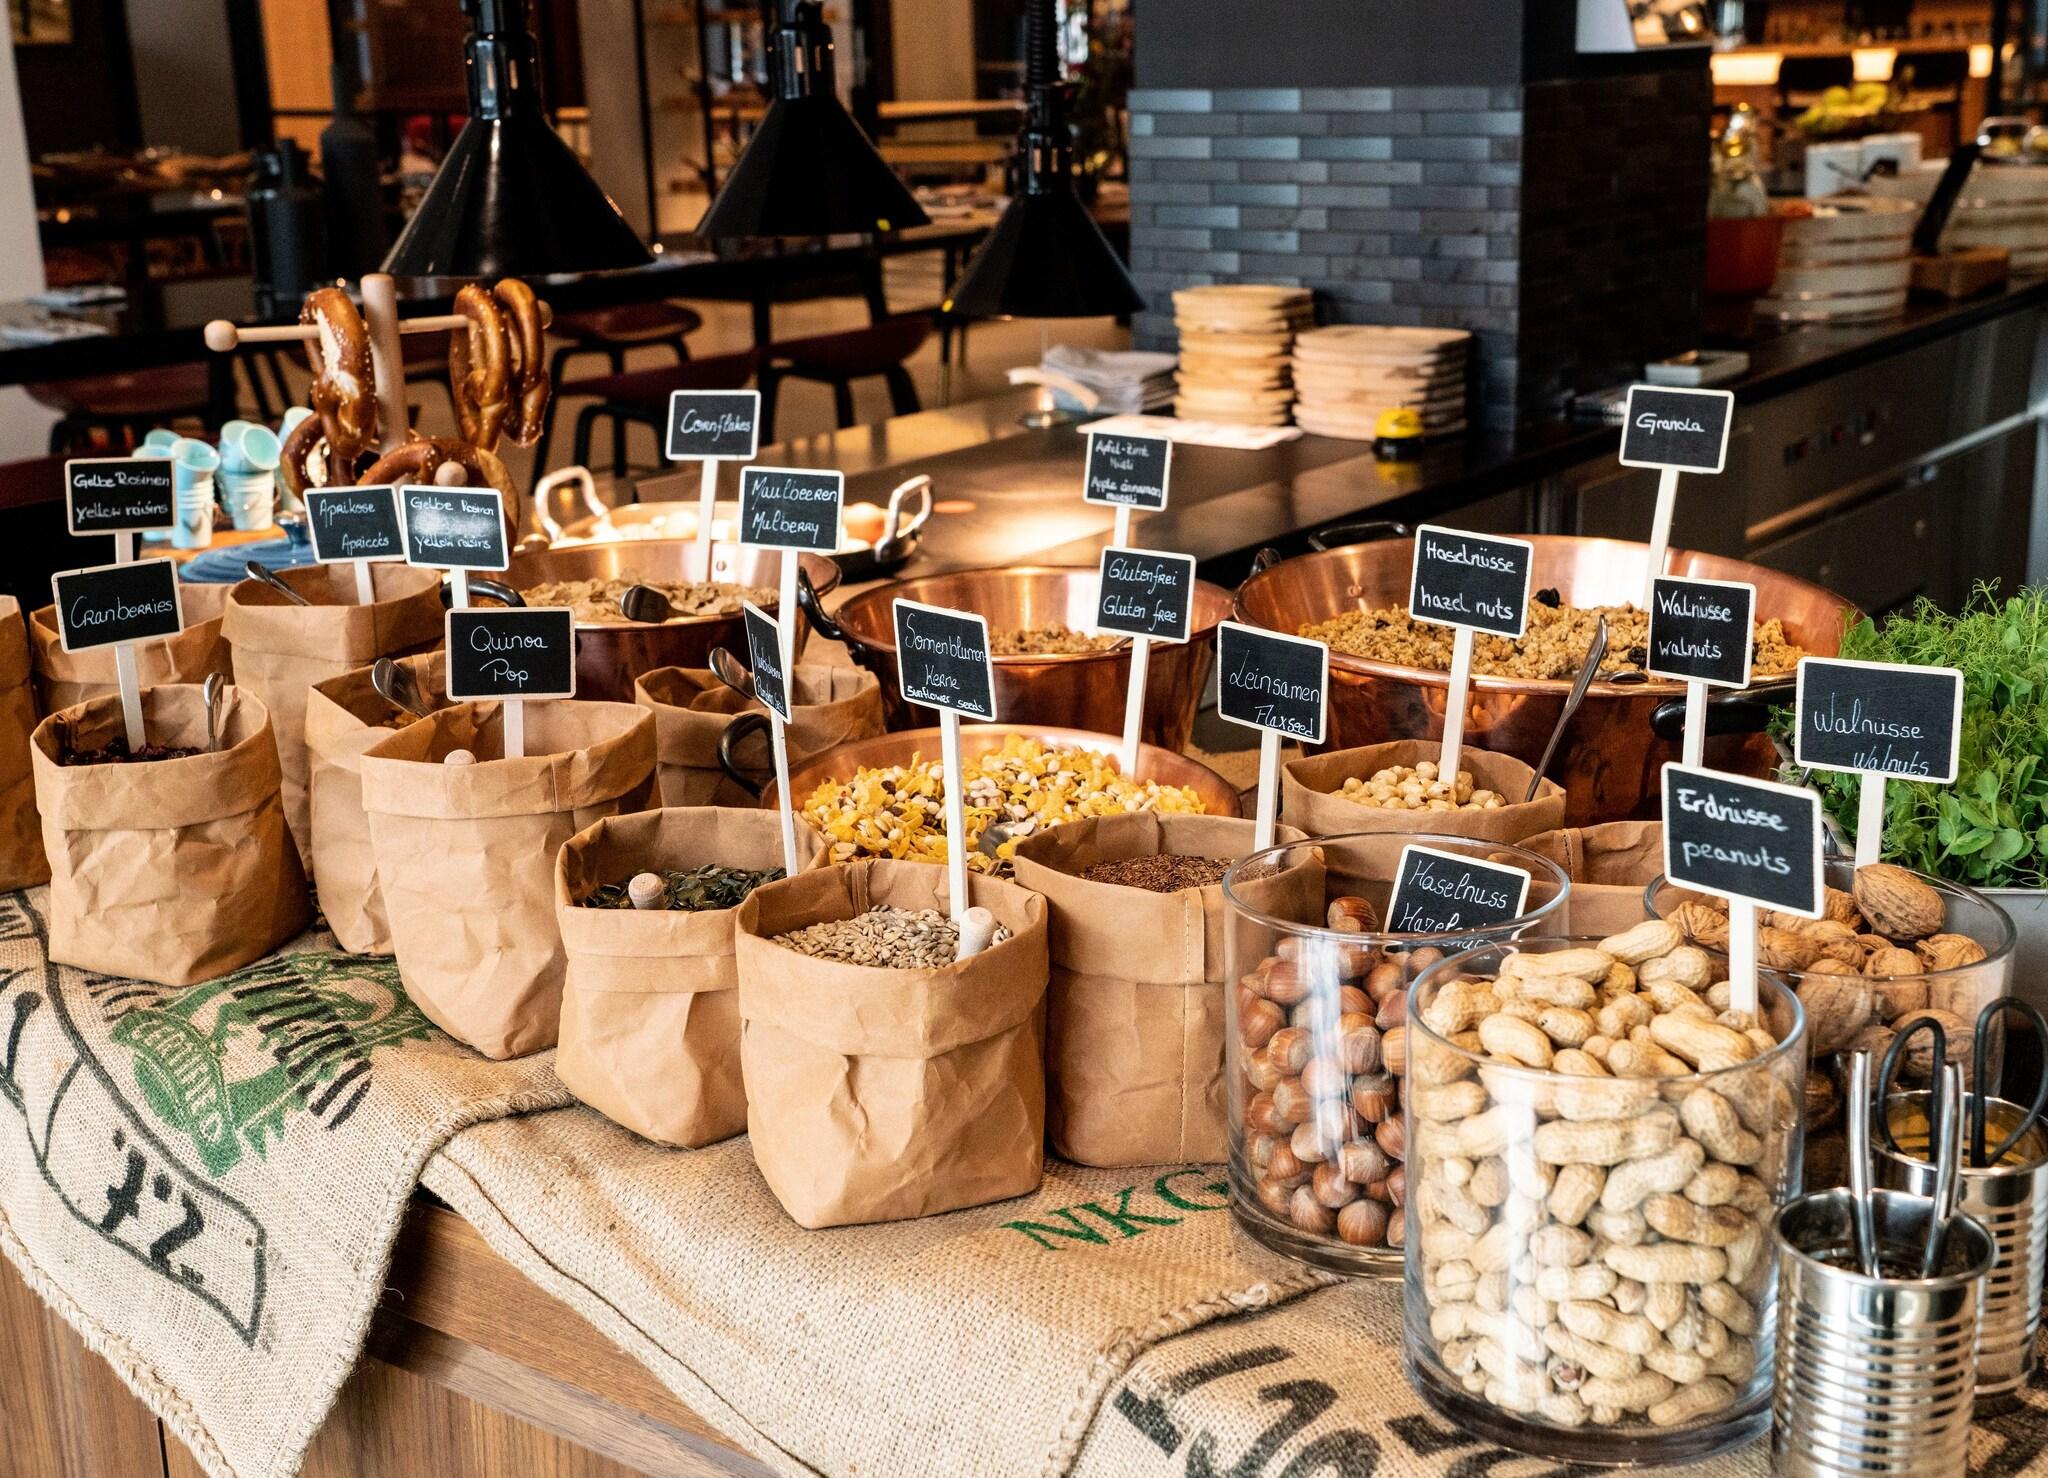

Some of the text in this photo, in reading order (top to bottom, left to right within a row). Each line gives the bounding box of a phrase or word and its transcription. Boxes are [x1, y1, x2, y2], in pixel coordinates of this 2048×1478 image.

[681, 409, 751, 442] Cornflakes
[1636, 412, 1705, 435] Granola
[751, 476, 838, 511] Maulbeeren
[319, 497, 376, 529] Aprikose
[752, 510, 820, 545] Mulberry
[70, 594, 174, 629] Cranberries
[1102, 595, 1177, 632] Gluten free
[1475, 596, 1515, 620] nuts
[1657, 590, 1733, 622] Walnüsse
[470, 625, 549, 654] Quinoa
[479, 657, 529, 689] Pop
[1229, 649, 1320, 704] Leinsamen
[907, 684, 950, 704] Sunflower
[1254, 704, 1314, 738] Flaxseed
[1813, 691, 1924, 740] Walnüsse
[1676, 787, 1789, 832] Erdnüsse
[1681, 841, 1792, 876] peanuts
[1408, 859, 1509, 909] Haselnuss
